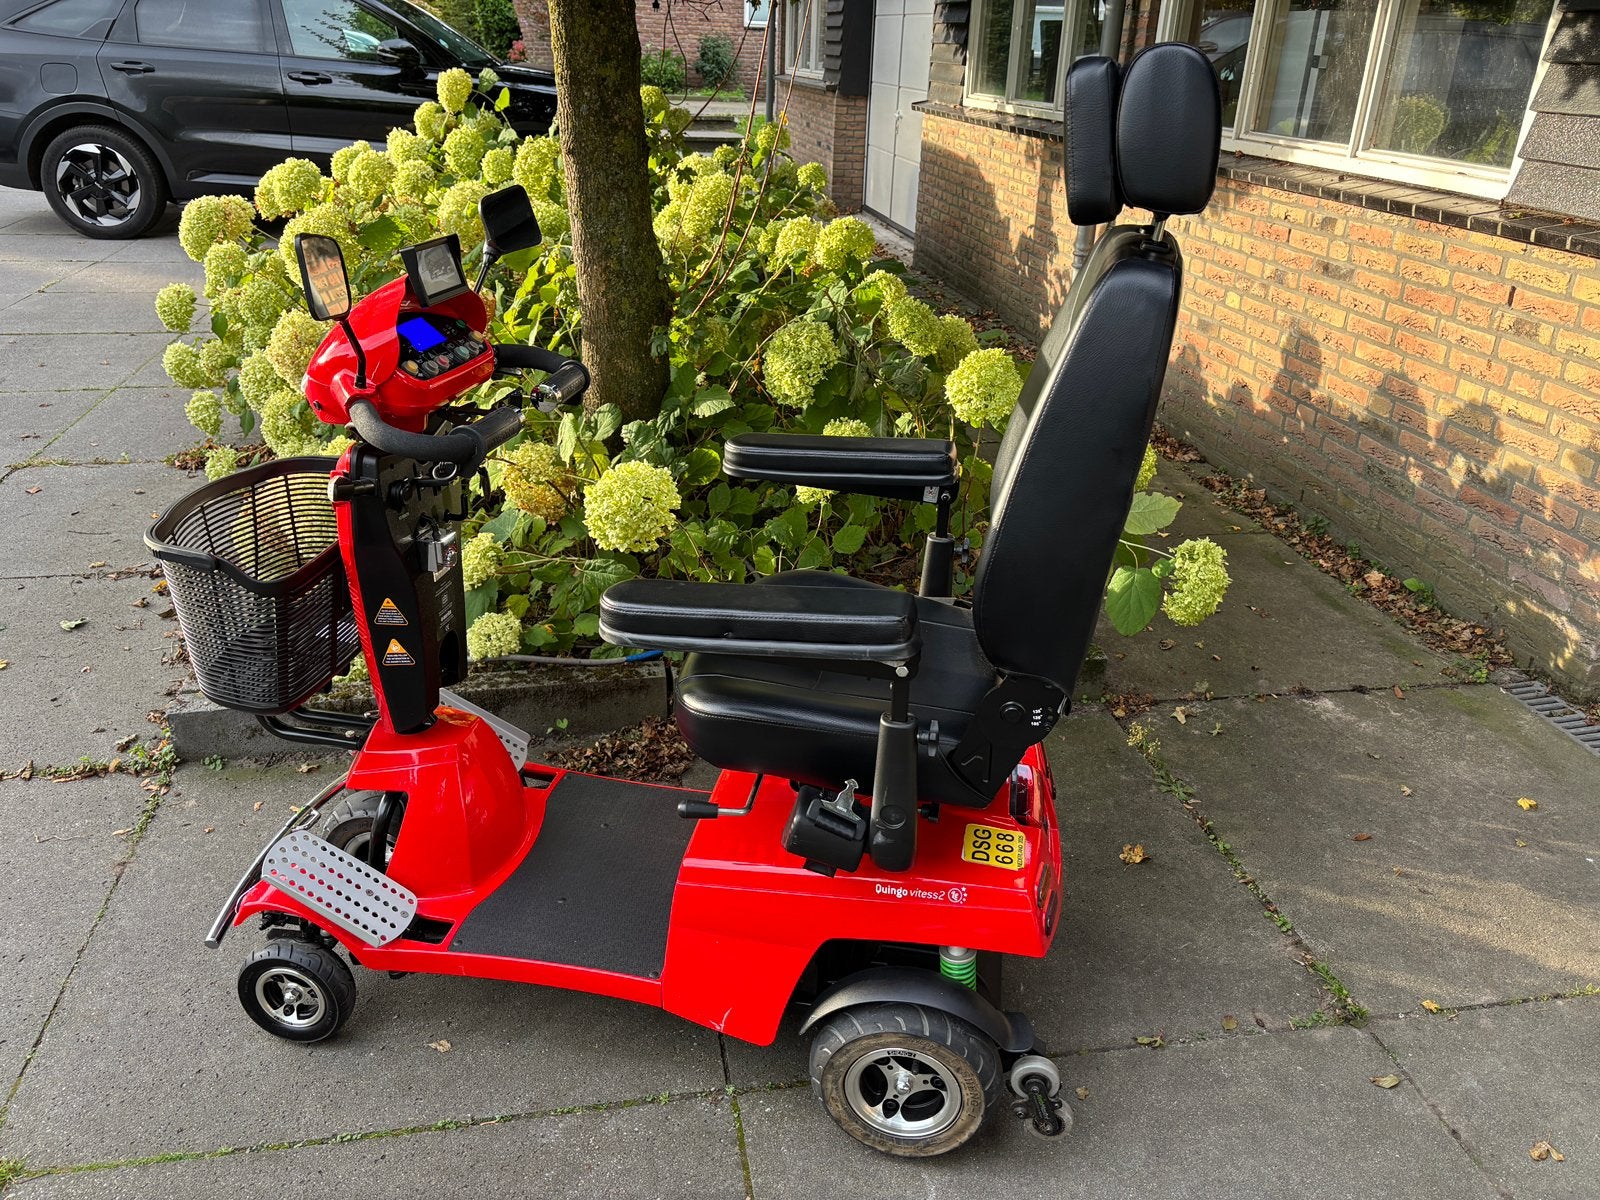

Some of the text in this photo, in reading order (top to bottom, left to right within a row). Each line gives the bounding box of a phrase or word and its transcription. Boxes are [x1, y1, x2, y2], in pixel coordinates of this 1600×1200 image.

[971, 828, 992, 862] DSG
[994, 832, 1015, 865] 668
[875, 883, 908, 899] Quingo
[909, 887, 946, 901] vitess2
